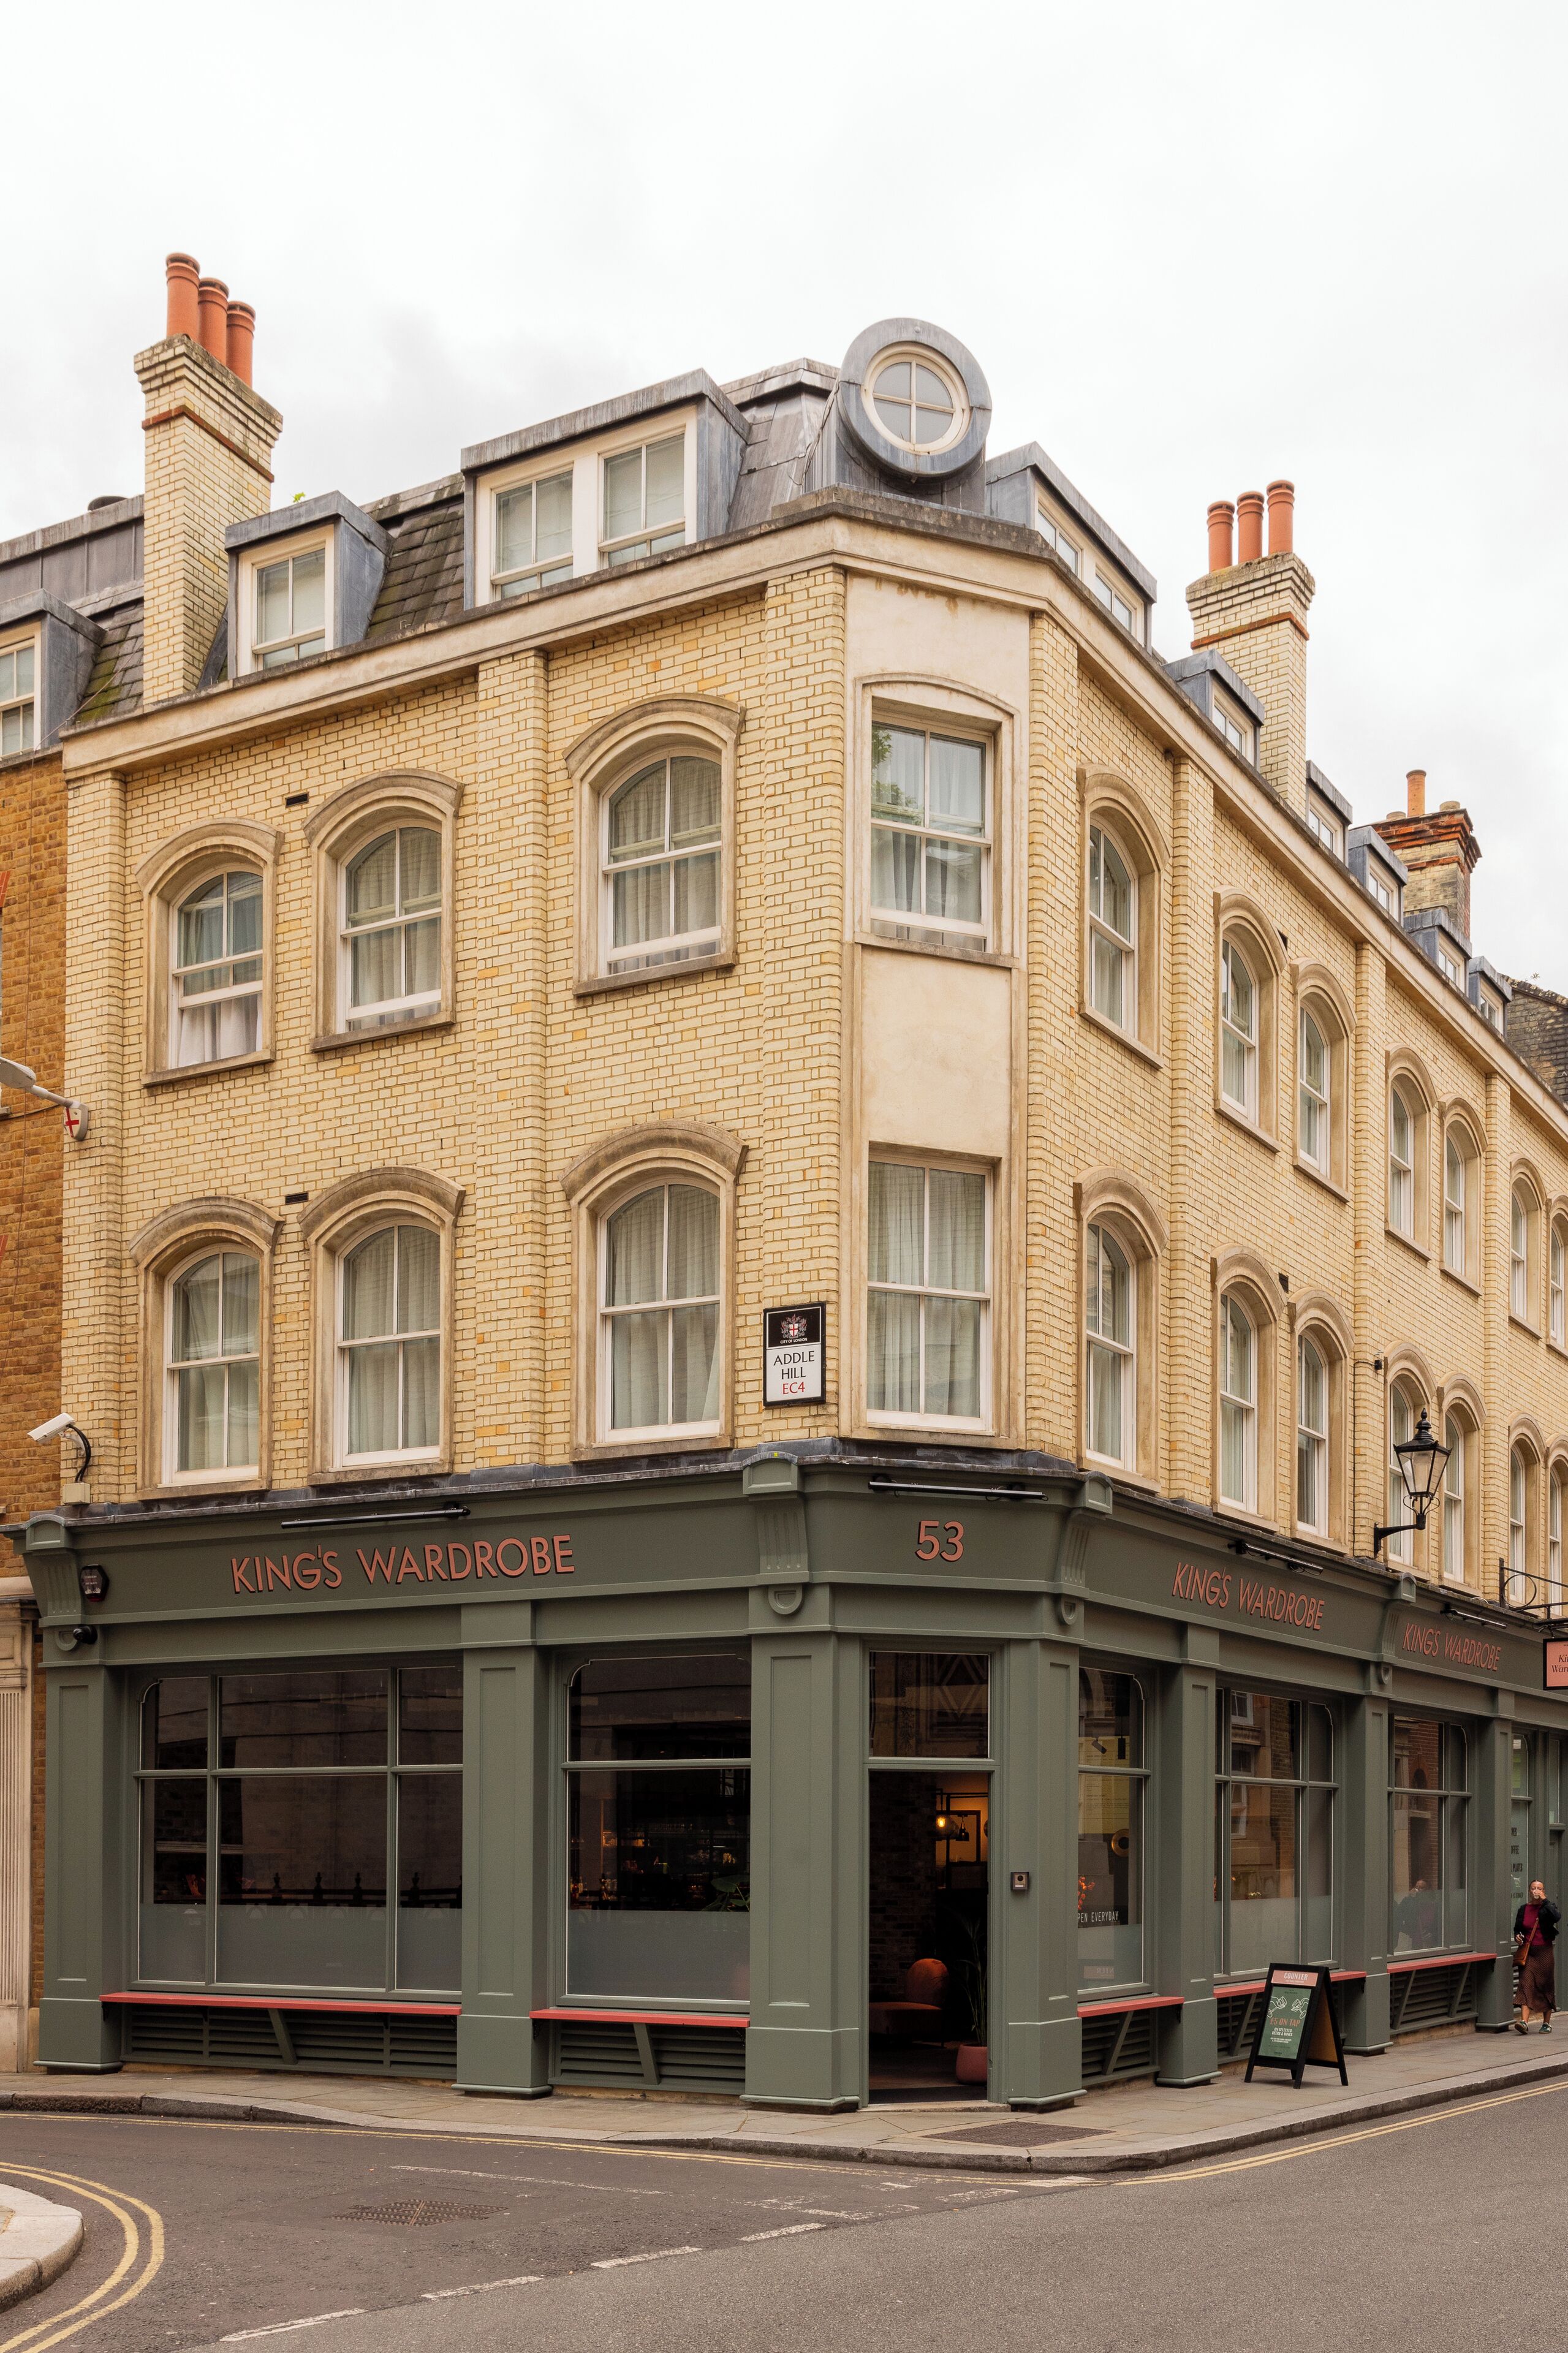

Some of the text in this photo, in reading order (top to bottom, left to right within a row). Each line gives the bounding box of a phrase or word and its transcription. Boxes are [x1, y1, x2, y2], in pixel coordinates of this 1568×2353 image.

[773, 1351, 814, 1366] ADDLE
[781, 1366, 806, 1379] HILL
[782, 1381, 805, 1395] EC4
[915, 1520, 964, 1562] 53
[231, 1534, 575, 1593] KING'S WARDROBE
[1172, 1562, 1325, 1631] KING'S WARDROBE
[1403, 1623, 1501, 1672] KING'S WARDROBE
[1077, 1911, 1119, 1923] PEN EVERYDAY
[1289, 2018, 1300, 2027] TAP
